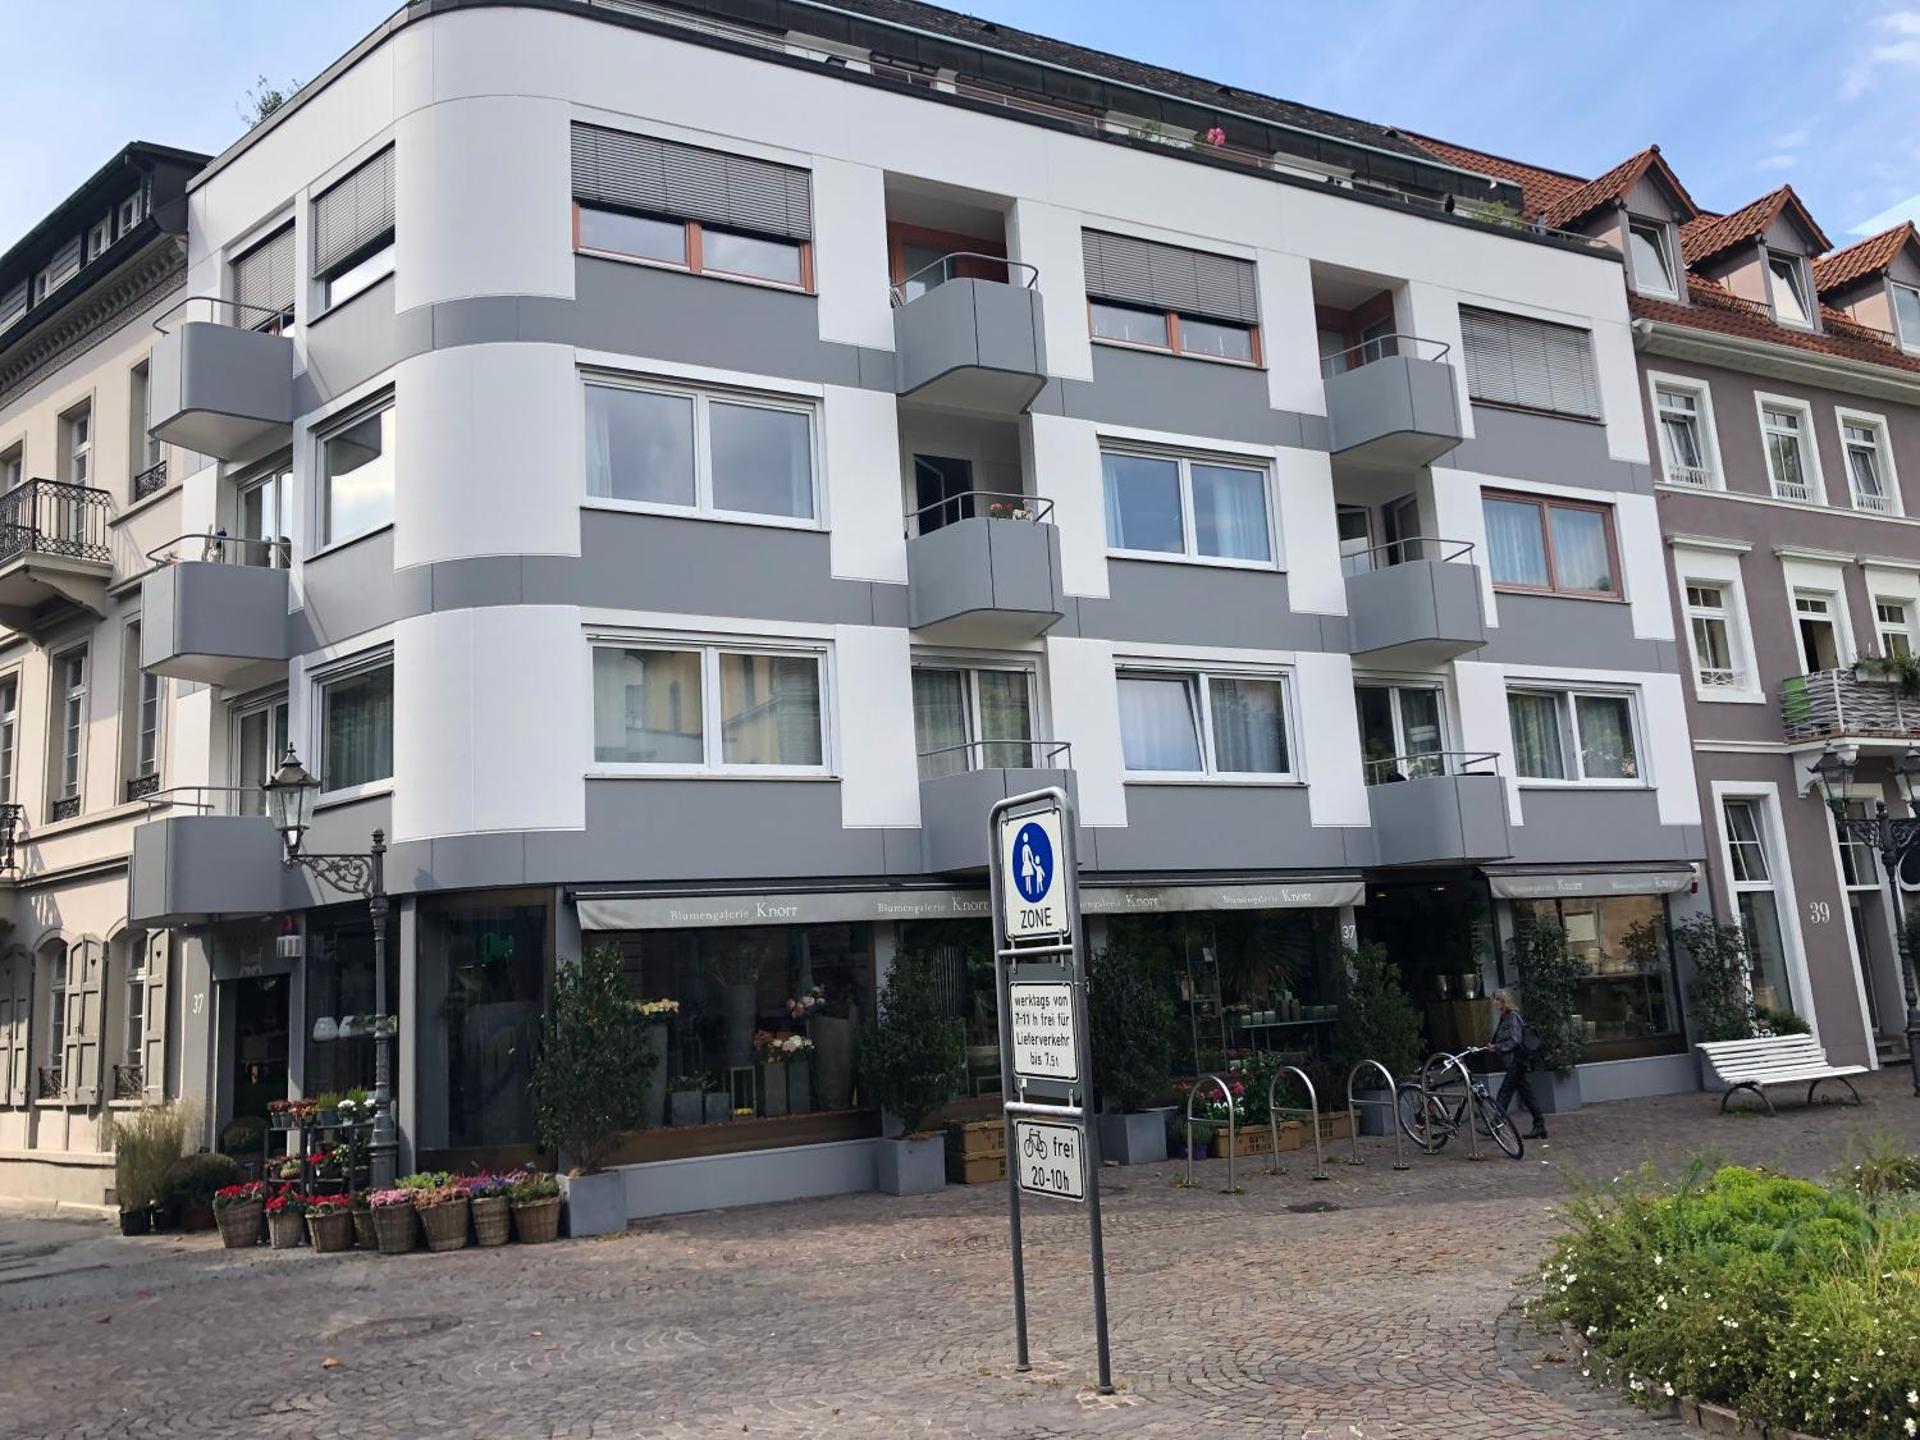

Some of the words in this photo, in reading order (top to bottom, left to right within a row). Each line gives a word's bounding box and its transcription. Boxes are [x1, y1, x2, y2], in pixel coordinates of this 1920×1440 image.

[670, 909, 749, 922] Blumengalerie
[756, 902, 799, 918] Knorr
[952, 896, 989, 911] Knorr
[1020, 907, 1052, 929] ZONE
[1810, 901, 1830, 924] 39
[1342, 924, 1356, 939] 37
[192, 993, 204, 1014] 37
[1014, 994, 1050, 1009] werktags
[1053, 995, 1068, 1006] von
[1015, 1012, 1030, 1025] 7-11
[1032, 1012, 1039, 1026] h
[1041, 1013, 1055, 1026] frei
[1057, 1012, 1070, 1026] für
[1015, 1032, 1070, 1047] Lieferverkehr
[1030, 1051, 1043, 1066] bis
[1053, 1136, 1074, 1159] frei
[1031, 1165, 1070, 1191] 20-10h
